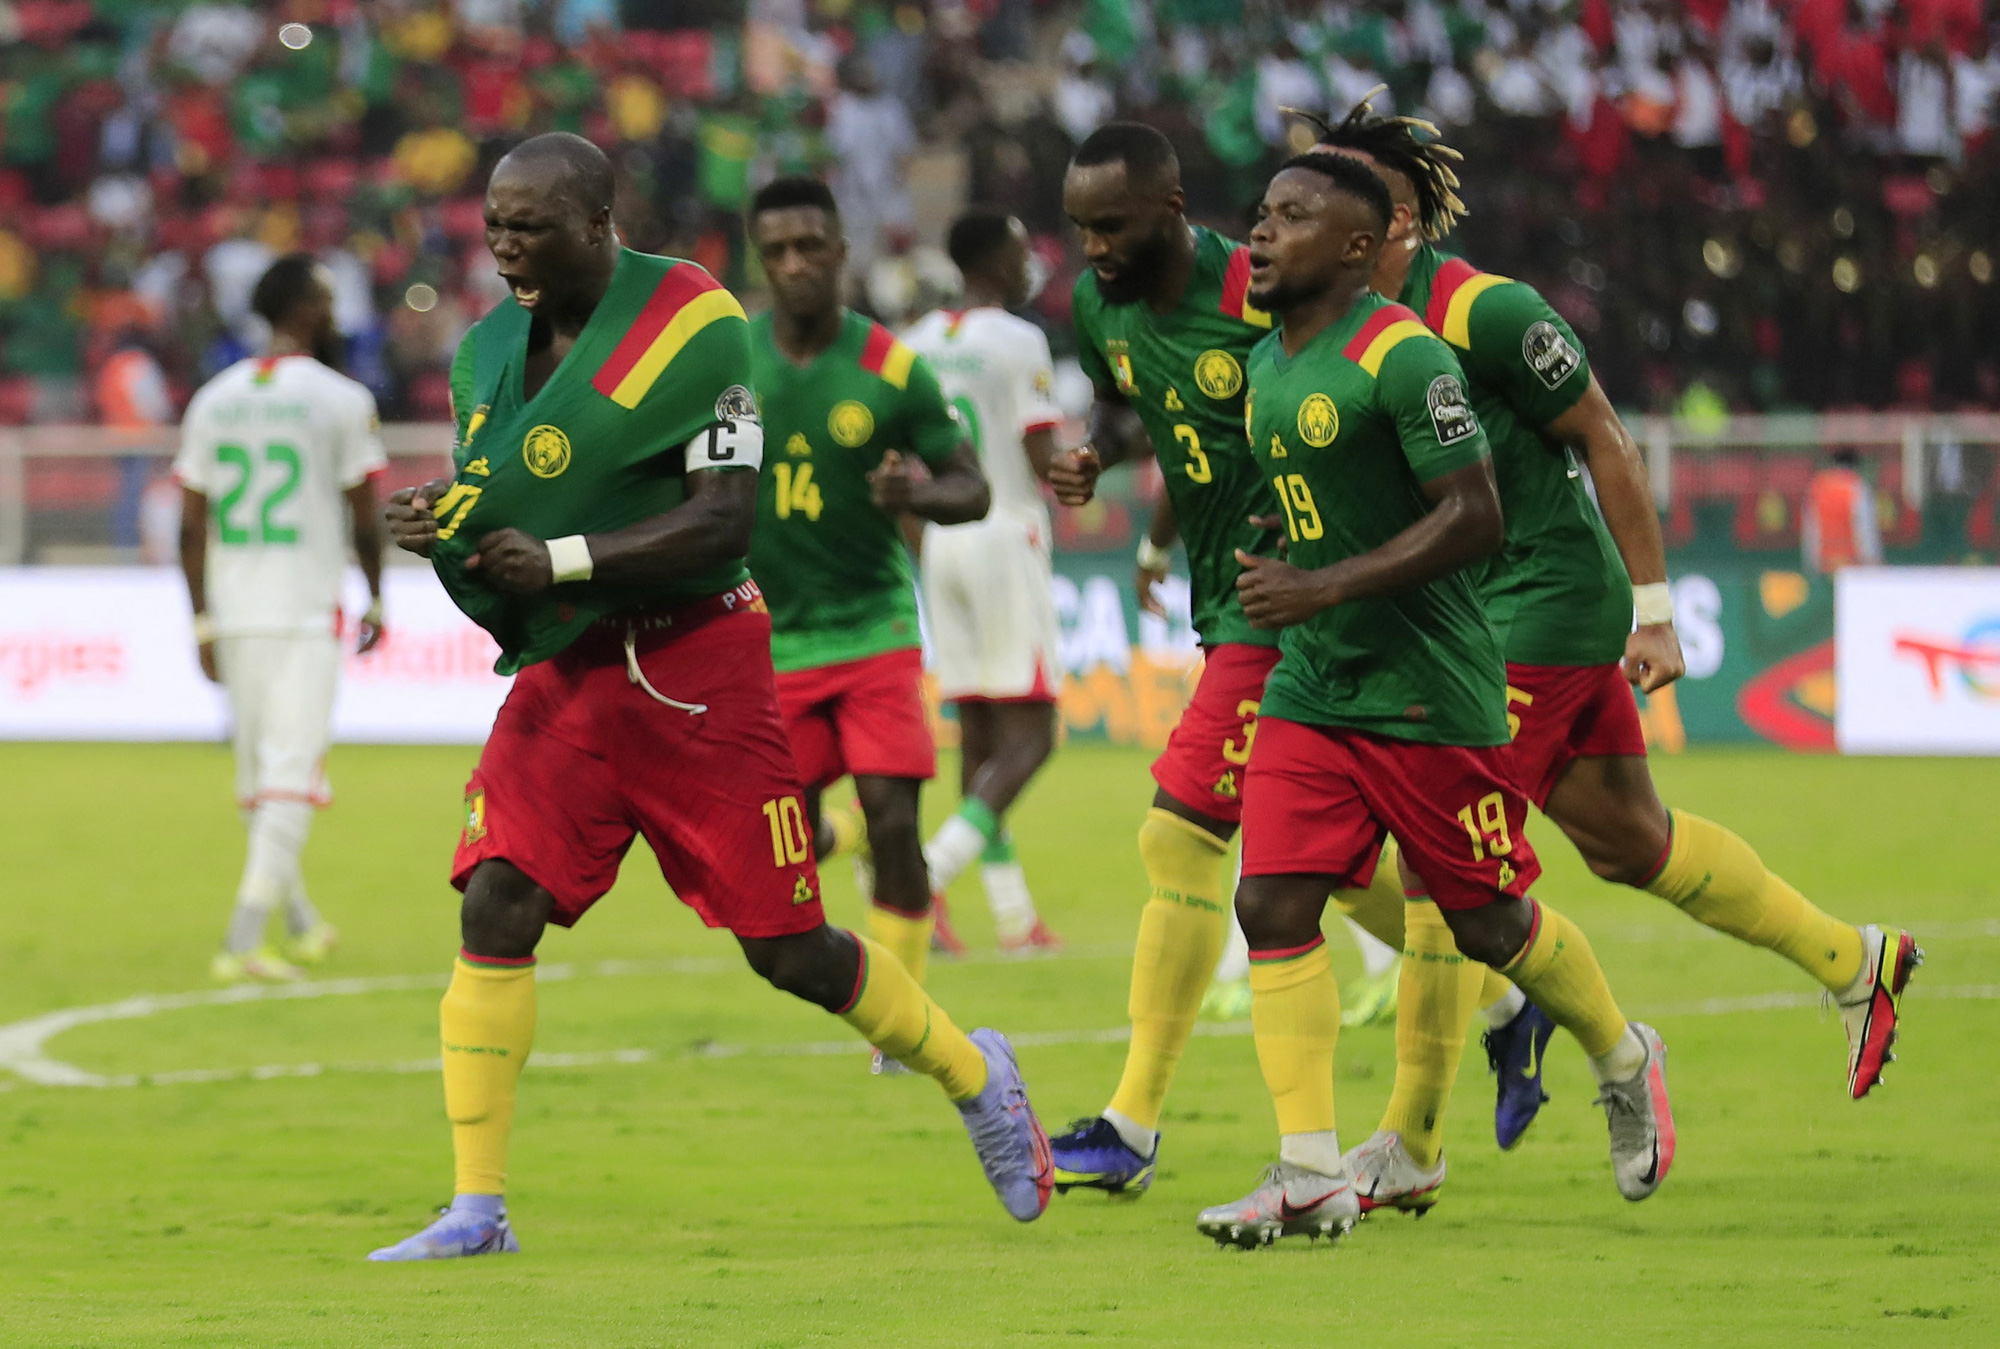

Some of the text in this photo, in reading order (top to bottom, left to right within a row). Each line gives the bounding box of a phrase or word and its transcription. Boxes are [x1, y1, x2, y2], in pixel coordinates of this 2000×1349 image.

[708, 421, 736, 461] C
[1173, 424, 1212, 483] 3
[215, 443, 301, 545] 22
[773, 462, 823, 521] 14
[1273, 474, 1323, 542] 19
[1222, 699, 1260, 765] 3
[763, 796, 808, 868] 10
[1458, 791, 1512, 863] 19
